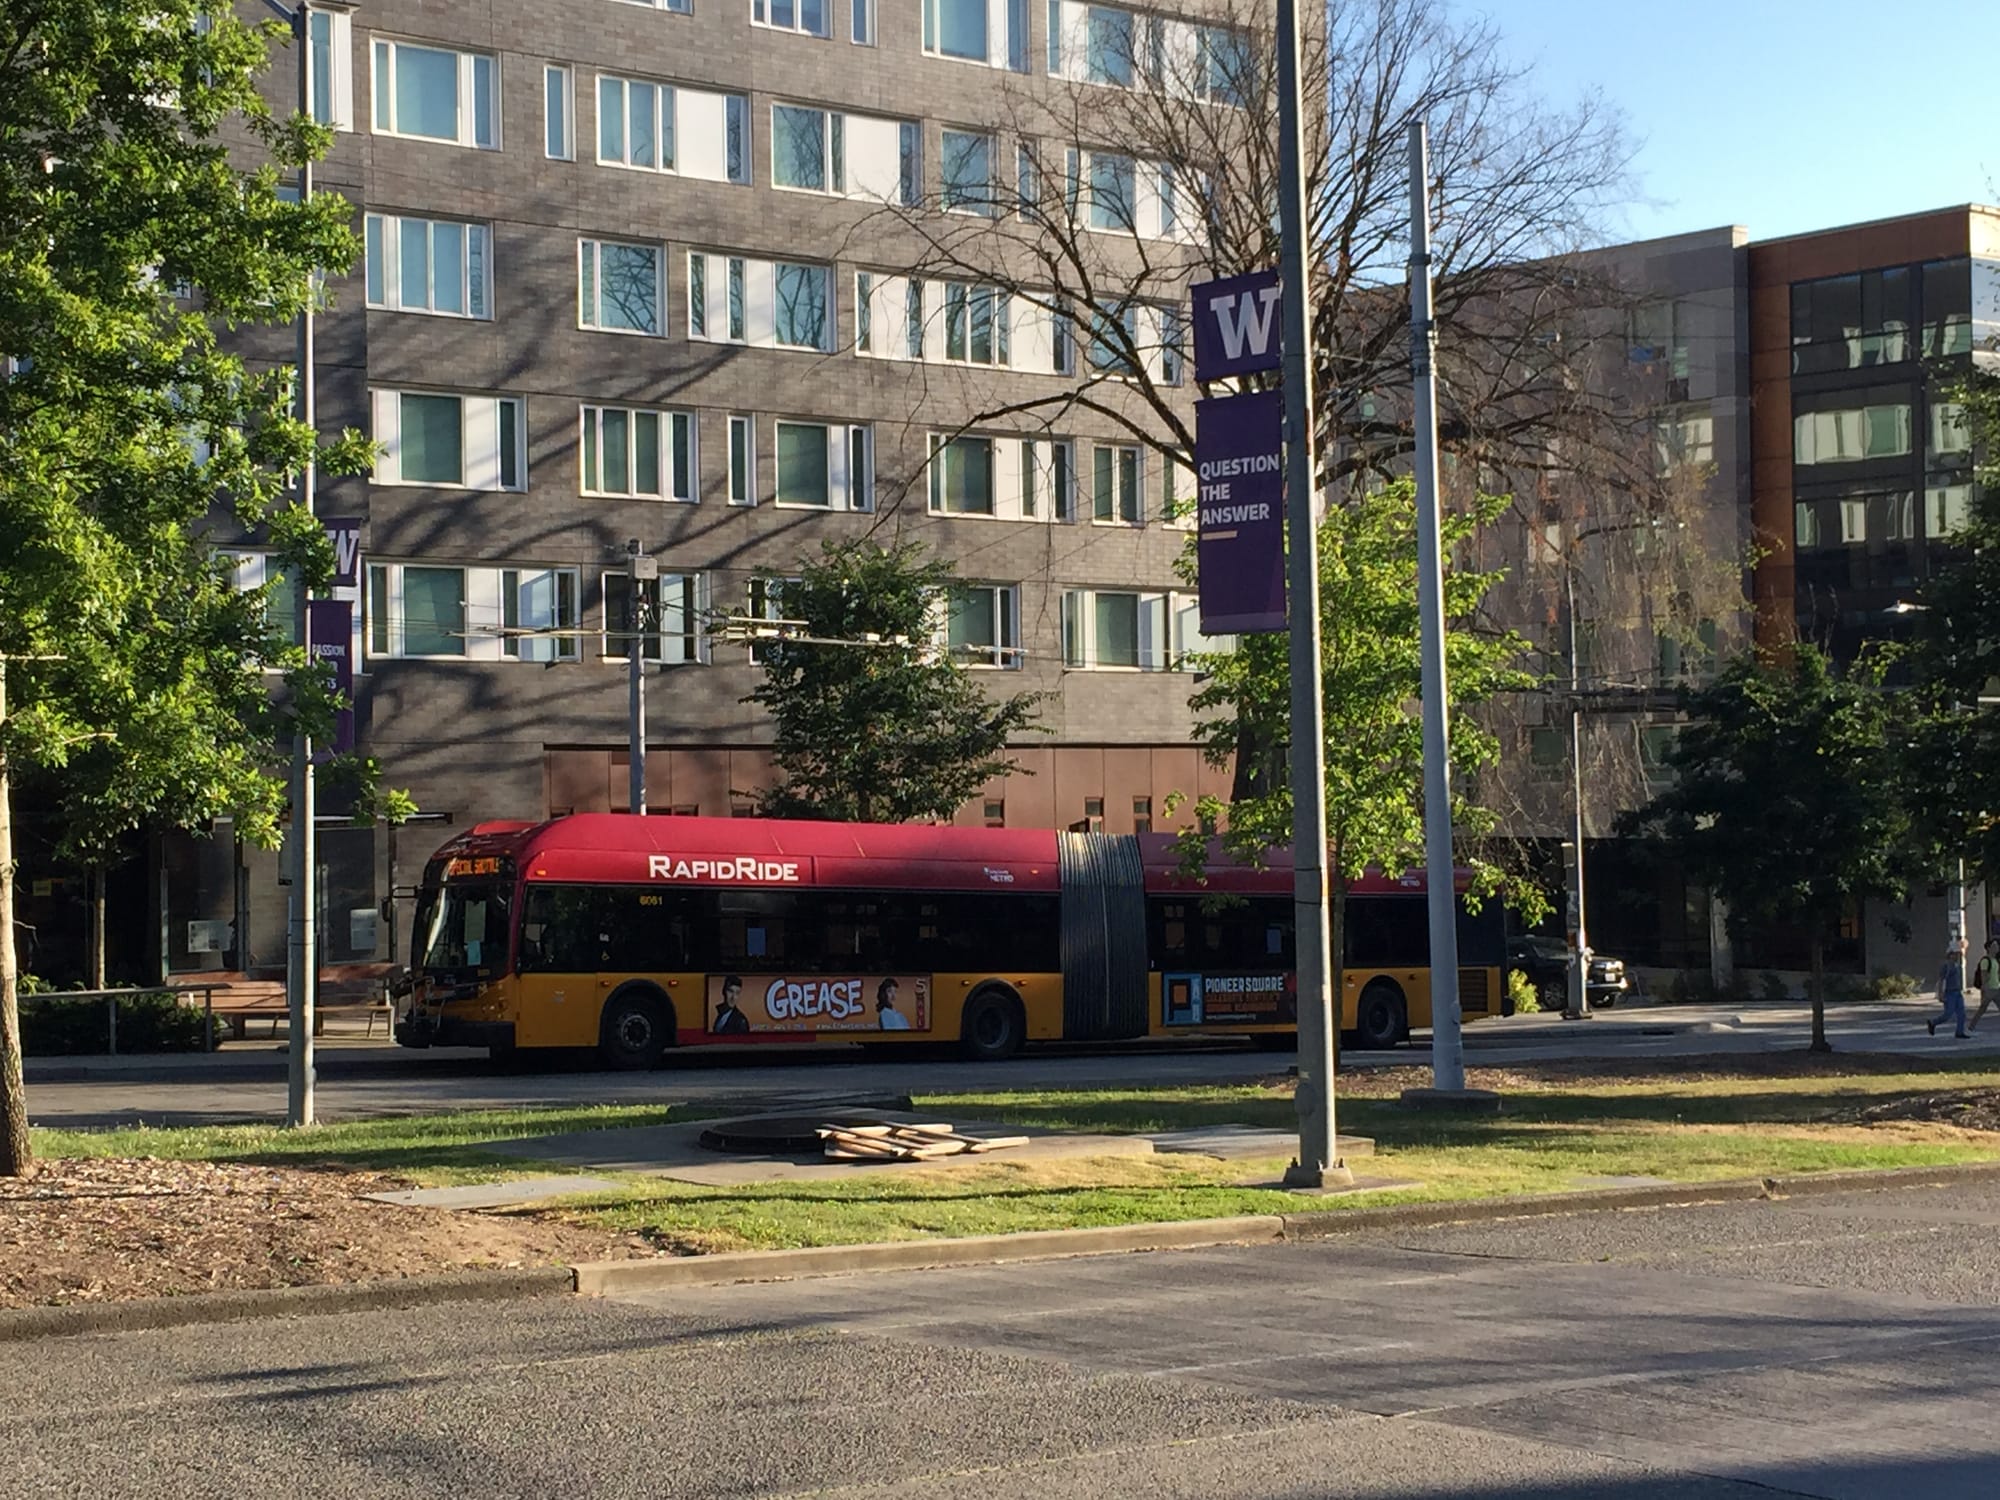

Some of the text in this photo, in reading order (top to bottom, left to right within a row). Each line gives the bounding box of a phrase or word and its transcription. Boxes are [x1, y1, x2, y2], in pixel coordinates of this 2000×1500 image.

[1210, 286, 1281, 360] W
[1200, 453, 1280, 478] QUESTION
[1201, 483, 1231, 502] THE
[1201, 503, 1270, 526] ANSWER
[312, 644, 346, 657] PASSION
[1205, 976, 1284, 993] PIONEER SQUARE
[766, 978, 864, 1020] GREASE
